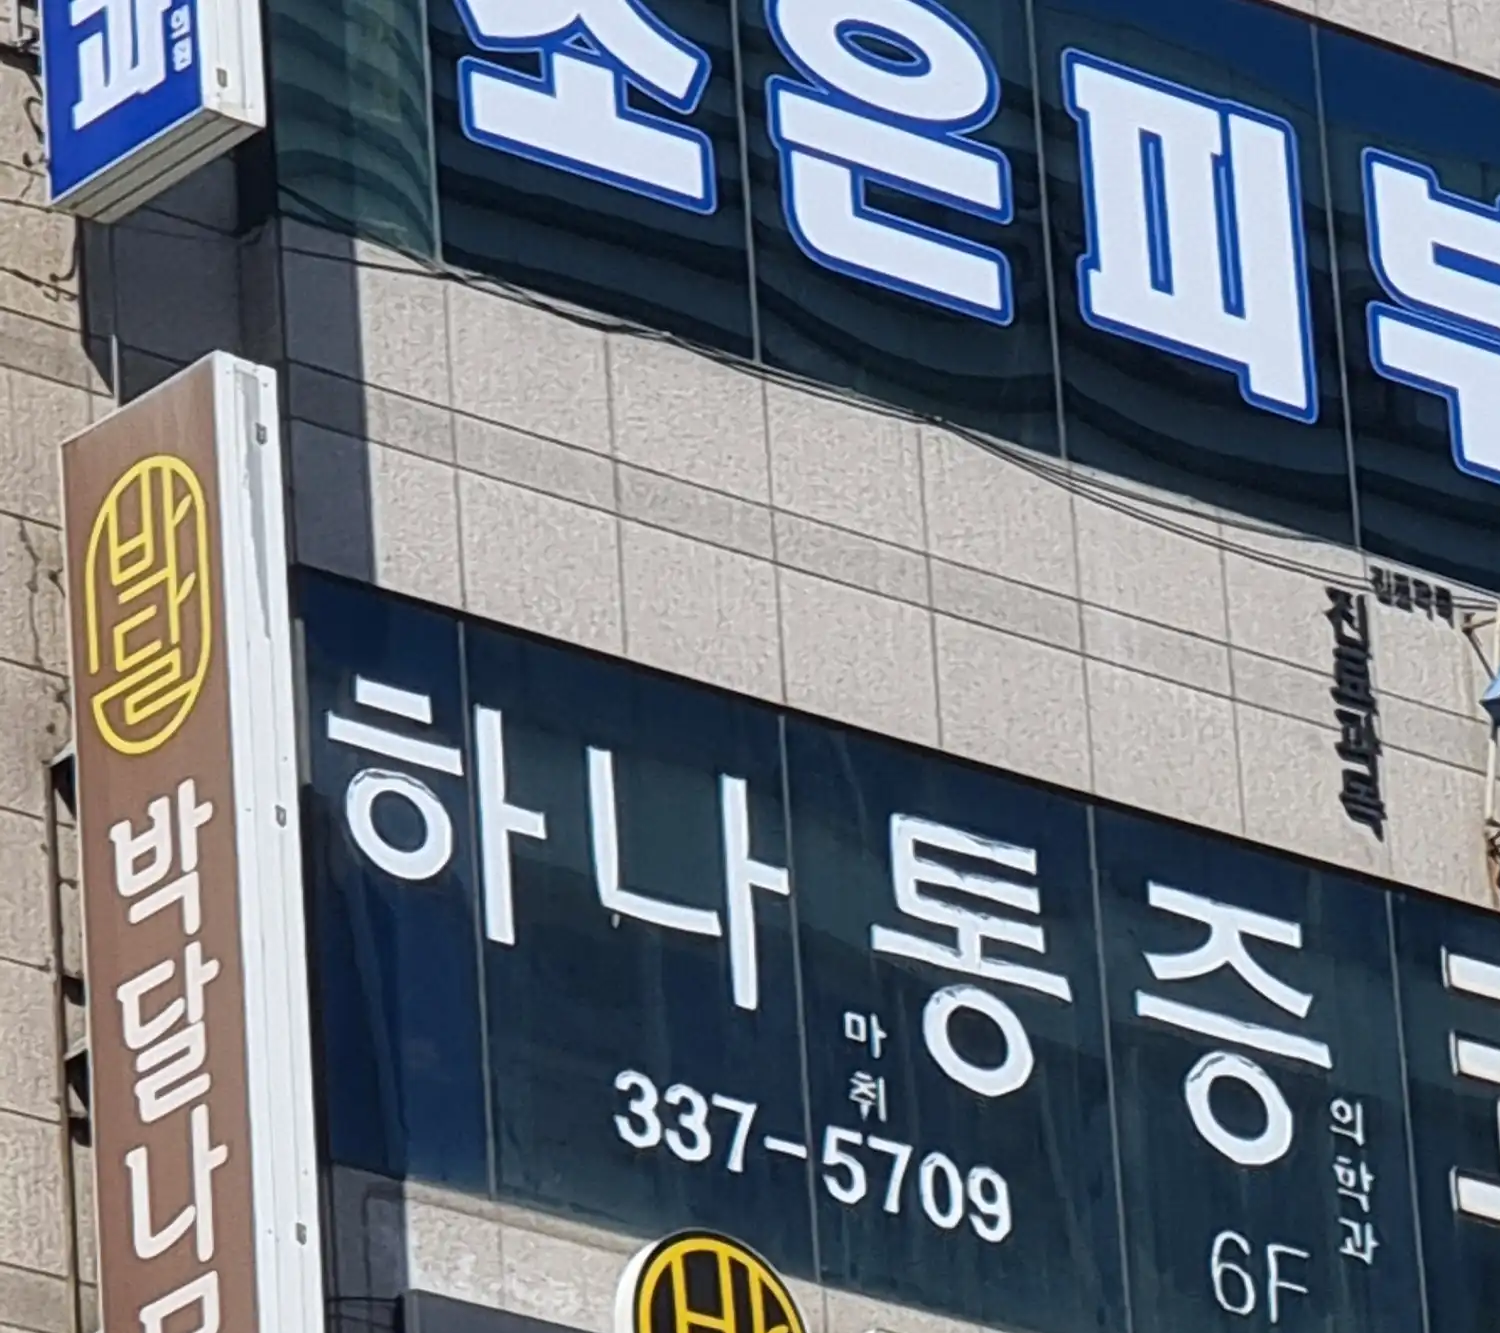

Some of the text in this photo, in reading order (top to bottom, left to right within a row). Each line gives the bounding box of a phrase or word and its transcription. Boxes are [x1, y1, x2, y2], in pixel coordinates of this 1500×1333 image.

[326, 675, 790, 1010] 하나
[843, 1010, 890, 1122] 마취
[870, 812, 1334, 1167] 통증
[612, 1068, 1013, 1243] 337-5709
[1330, 1097, 1377, 1265] 의학과
[1210, 1228, 1310, 1325] 6F
